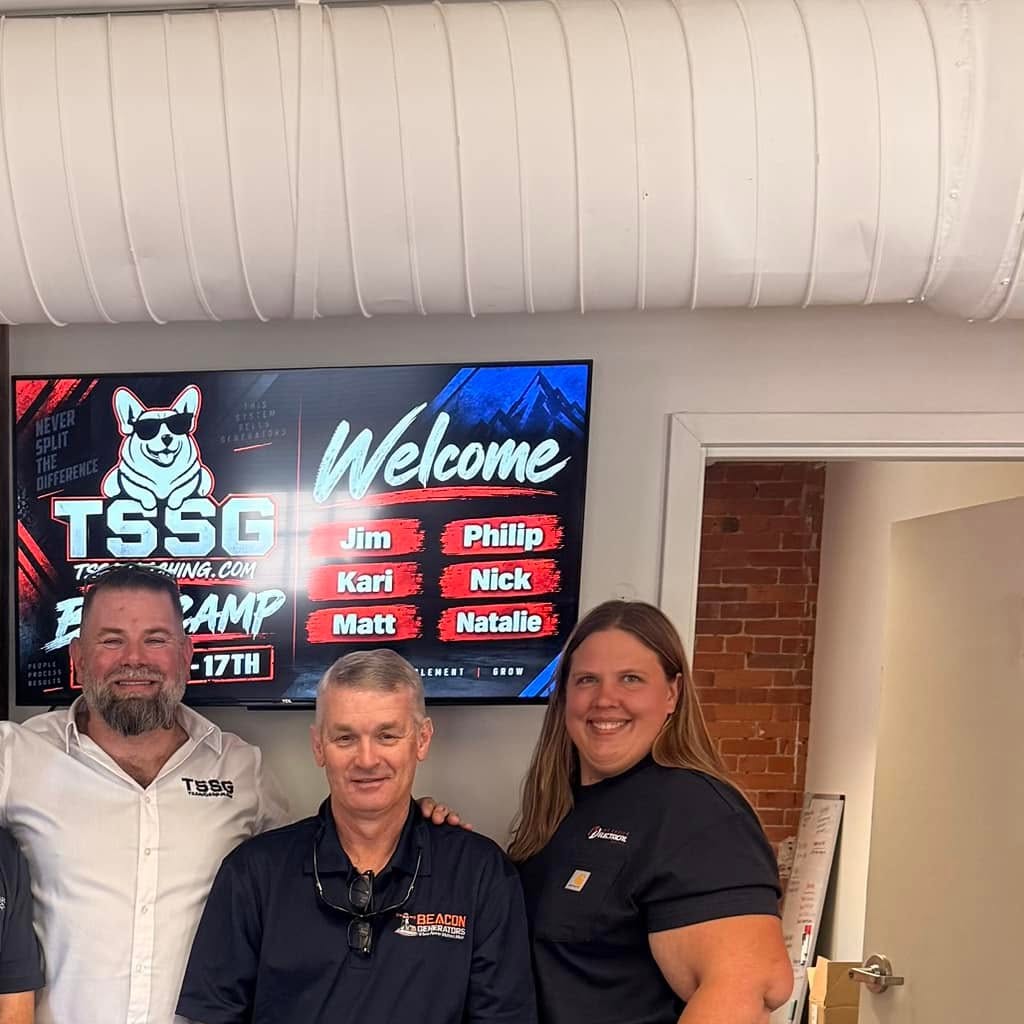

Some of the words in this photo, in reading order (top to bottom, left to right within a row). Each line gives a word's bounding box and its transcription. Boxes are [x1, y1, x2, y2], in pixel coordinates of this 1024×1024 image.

[36, 409, 76, 437] NEVER
[36, 430, 69, 456] SPLIT
[313, 402, 571, 503] Welcome
[36, 454, 57, 474] THE
[36, 458, 99, 491] DIFFERENCE
[54, 498, 275, 558] TSSG
[340, 526, 392, 550] Jim
[463, 521, 543, 551] Philip
[337, 568, 393, 593] Kari
[470, 567, 532, 591] Nick
[332, 612, 397, 636] Matt
[456, 611, 542, 634] Natalie
[416, 666, 464, 677] LEMENT
[492, 667, 524, 677] GROW
[181, 777, 234, 794] TSSG
[417, 912, 467, 928] BEACON
[417, 924, 467, 937] GENERATORS
